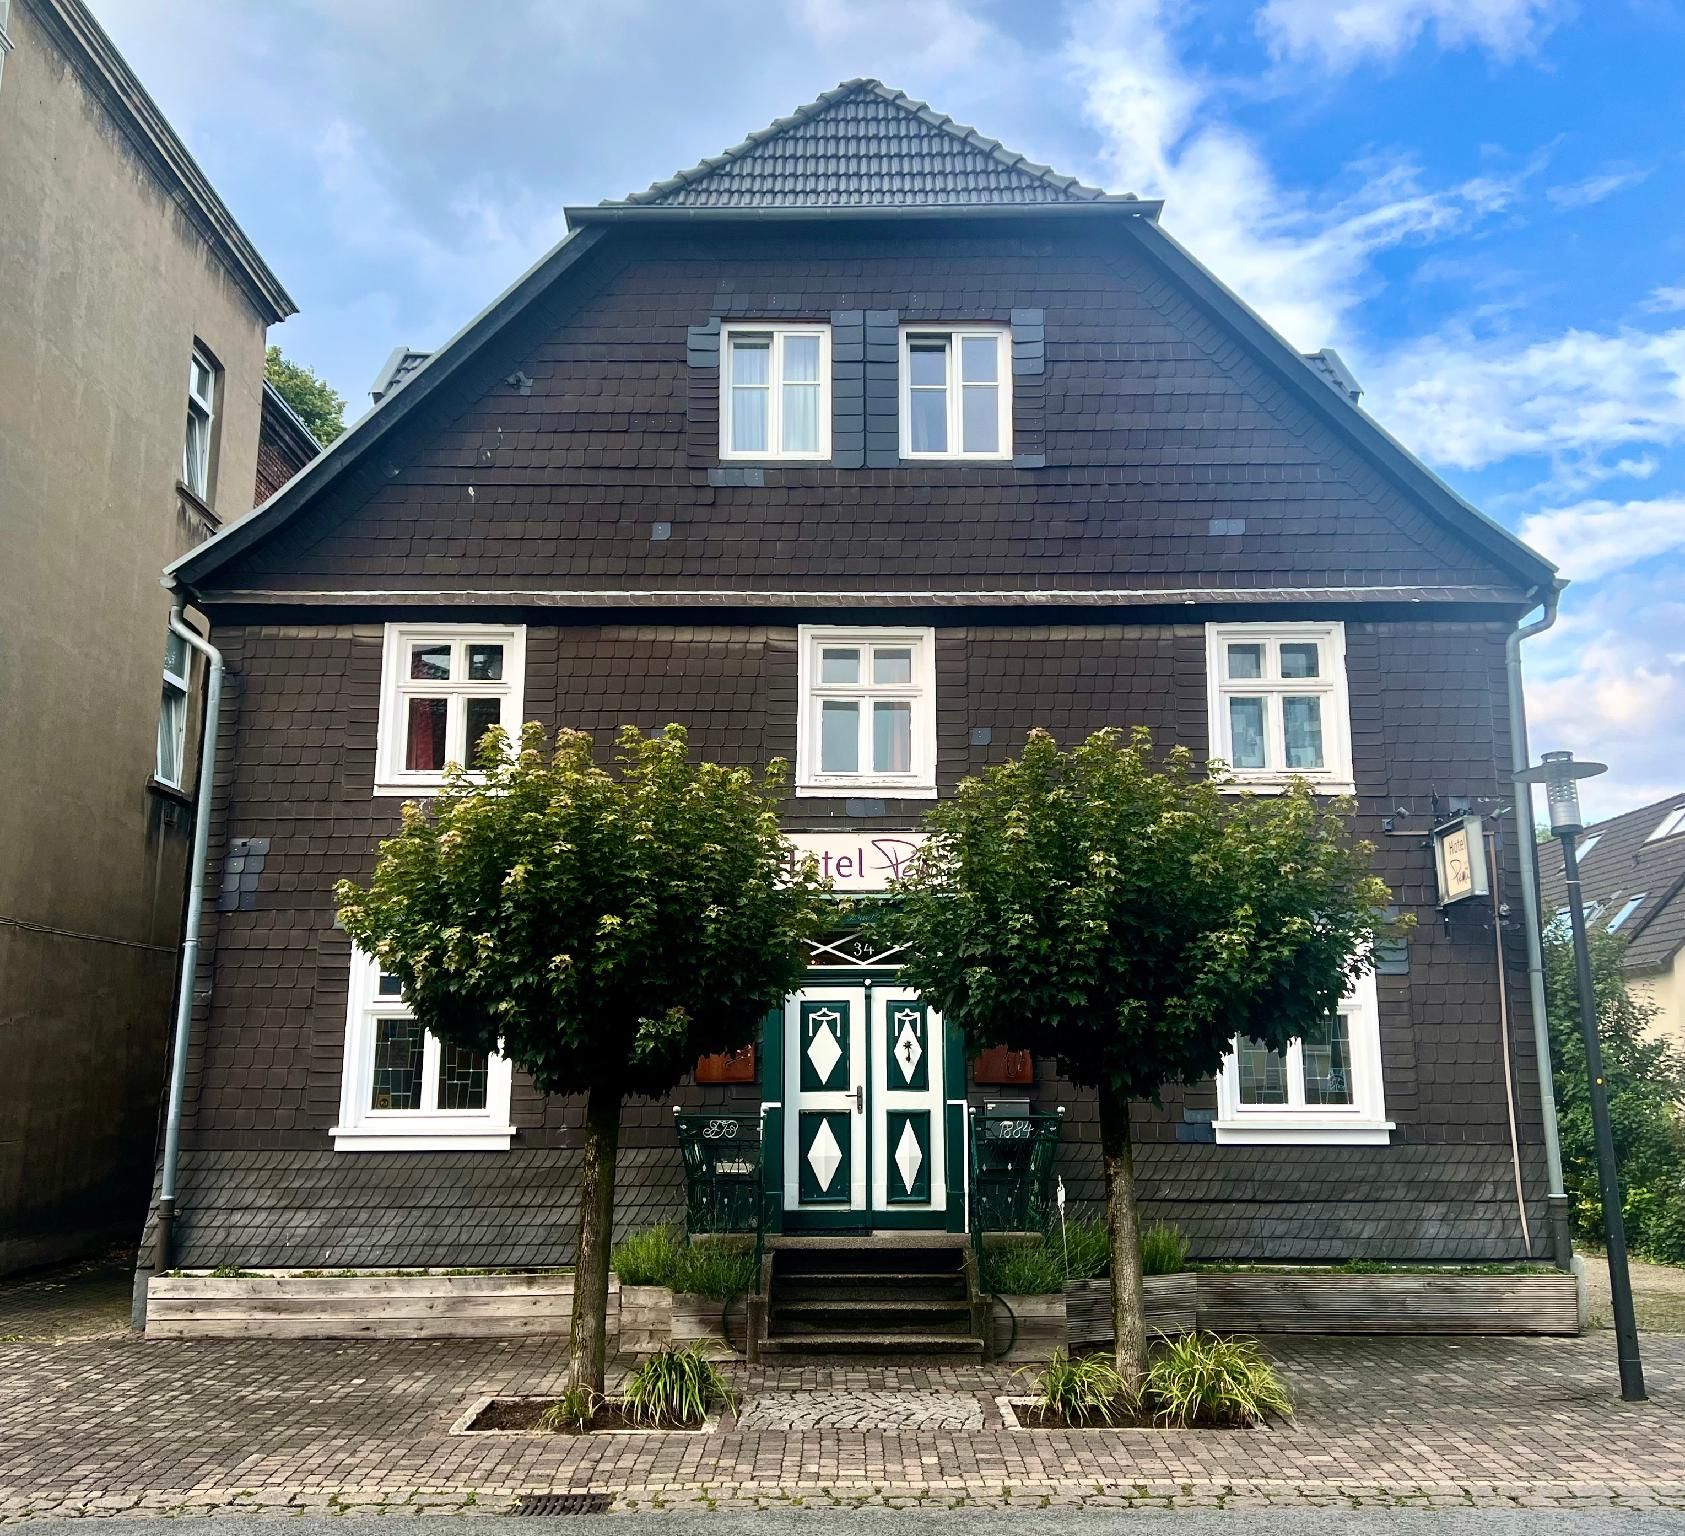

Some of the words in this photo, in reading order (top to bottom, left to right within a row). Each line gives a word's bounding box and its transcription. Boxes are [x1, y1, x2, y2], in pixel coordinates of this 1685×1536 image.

[774, 848, 864, 879] Htel
[853, 942, 875, 956] 34
[1000, 1120, 1034, 1139] 1884
